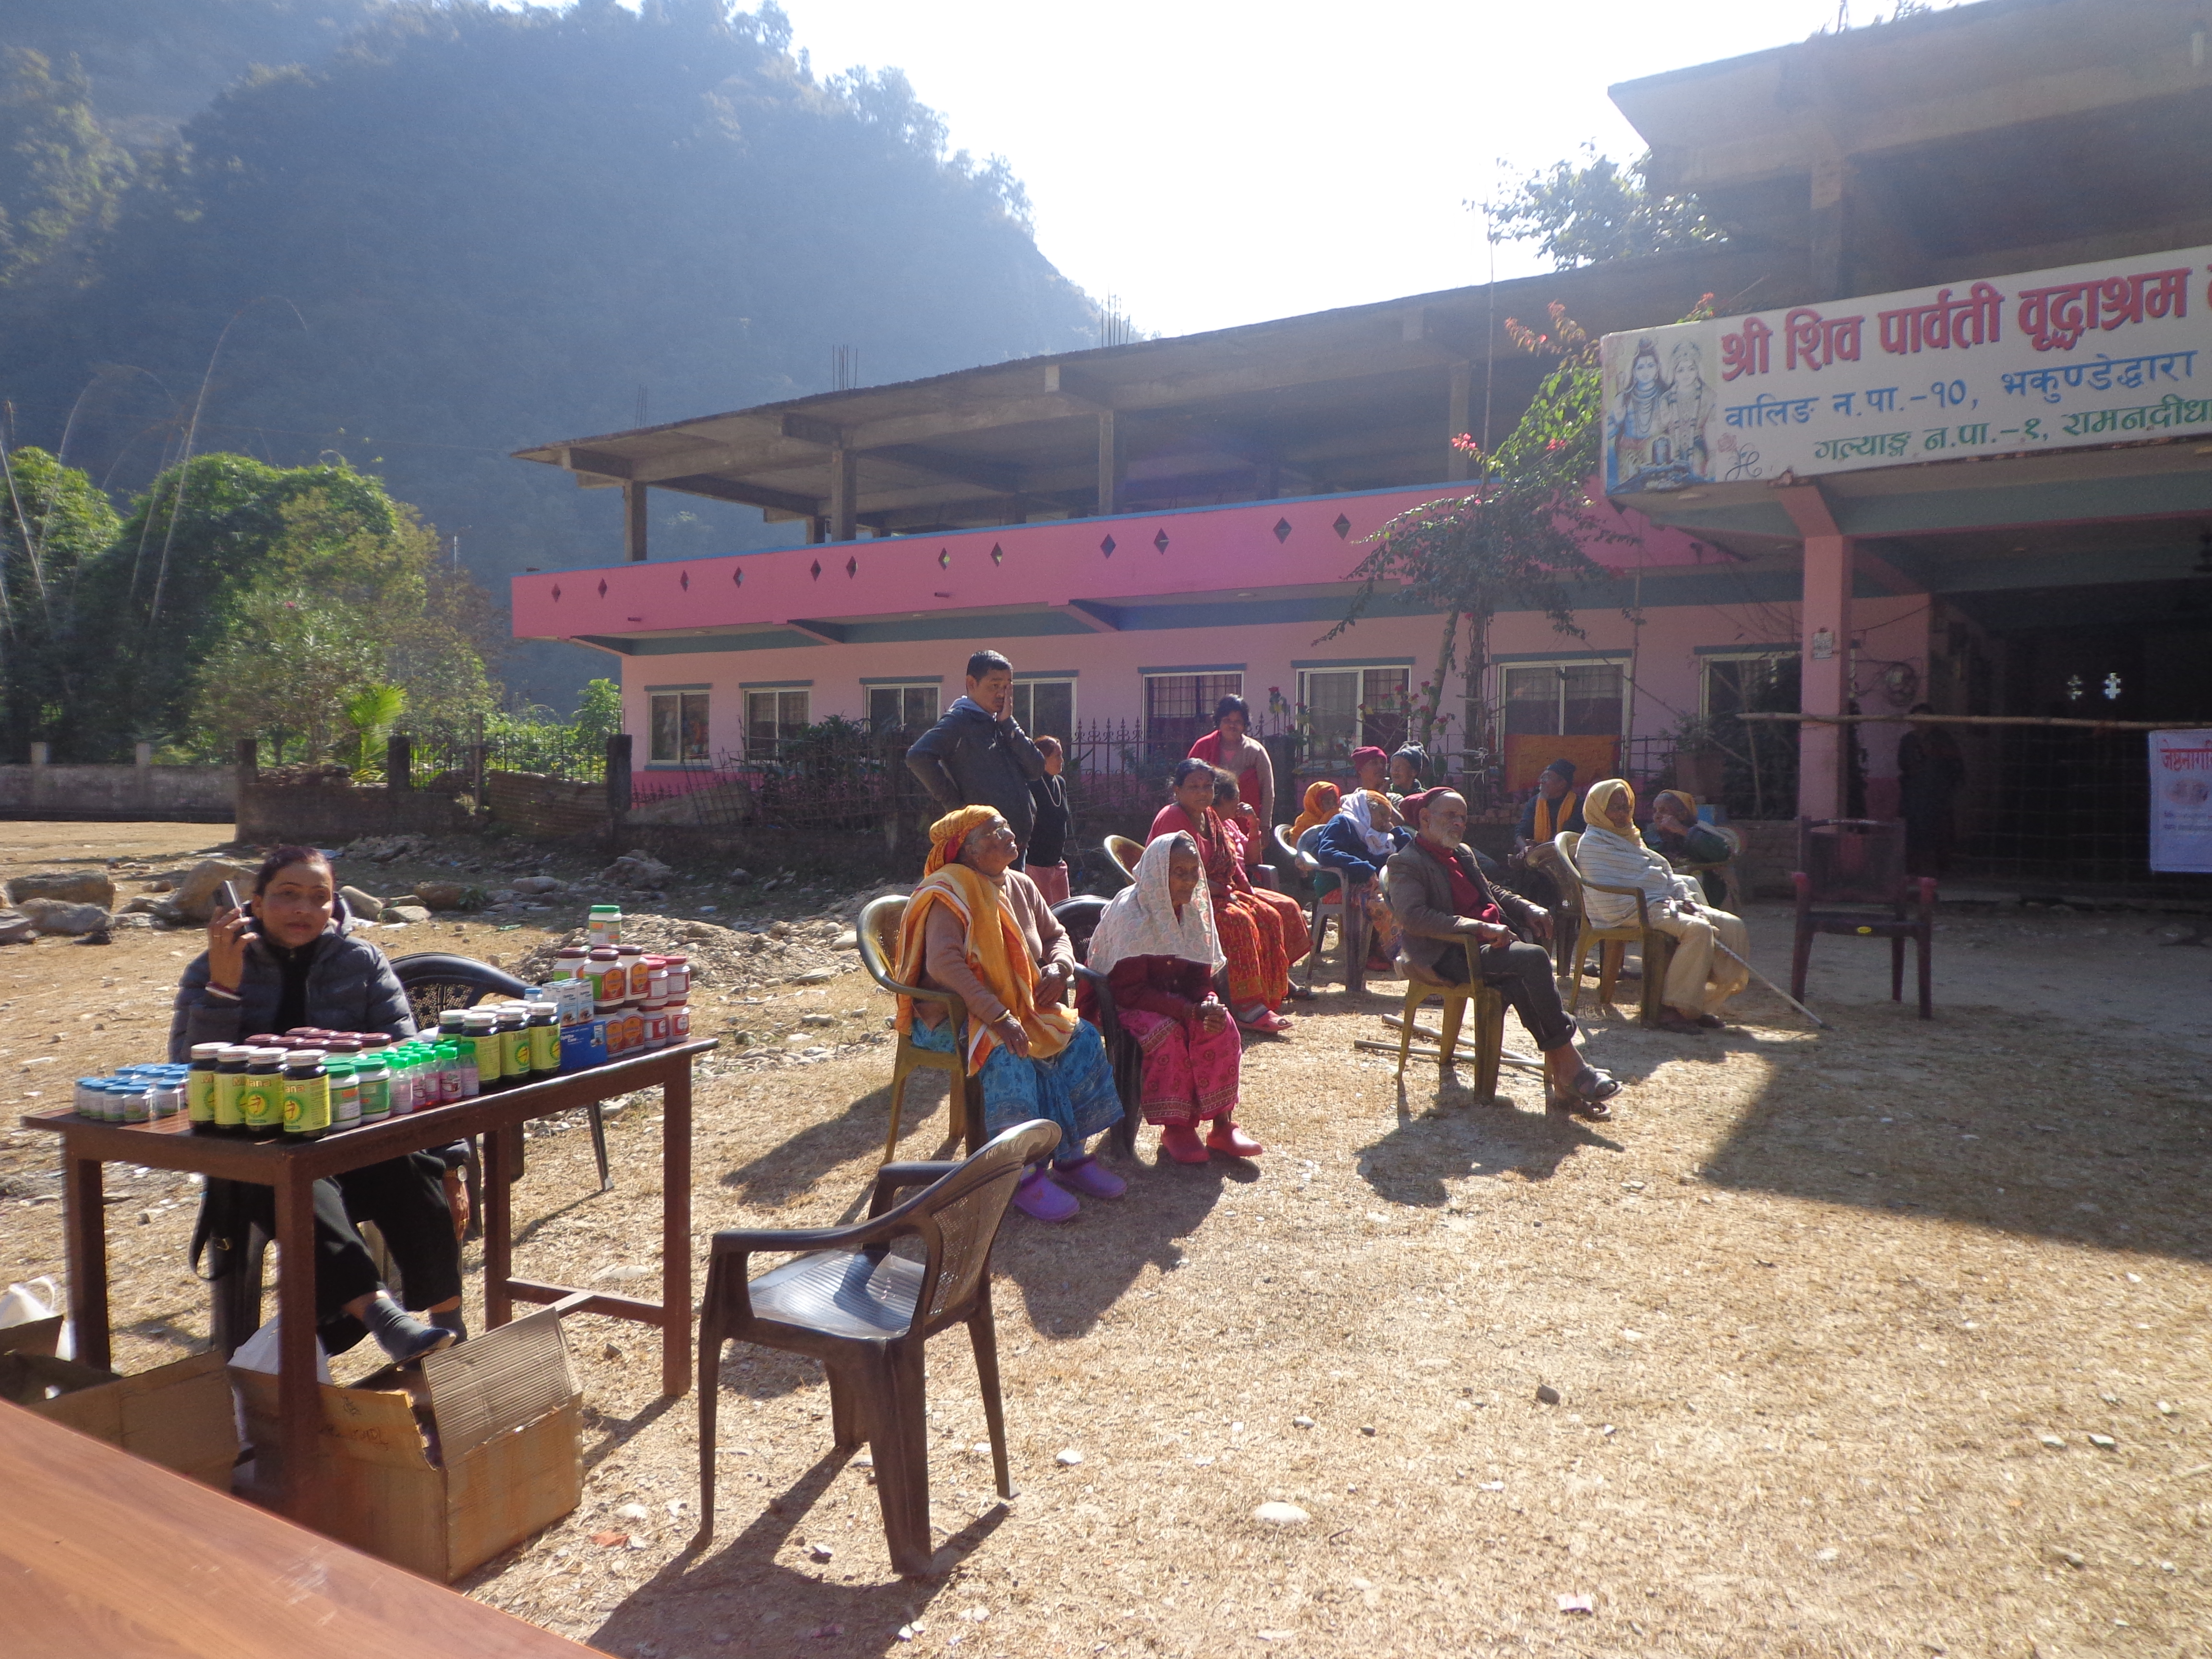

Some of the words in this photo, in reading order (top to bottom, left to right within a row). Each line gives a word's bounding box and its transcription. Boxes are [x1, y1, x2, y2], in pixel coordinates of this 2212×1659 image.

[1721, 316, 1773, 382] श्री
[1785, 307, 1866, 371] शिव
[1878, 281, 2006, 355] पार्वती
[1725, 393, 1820, 428] वालिङ
